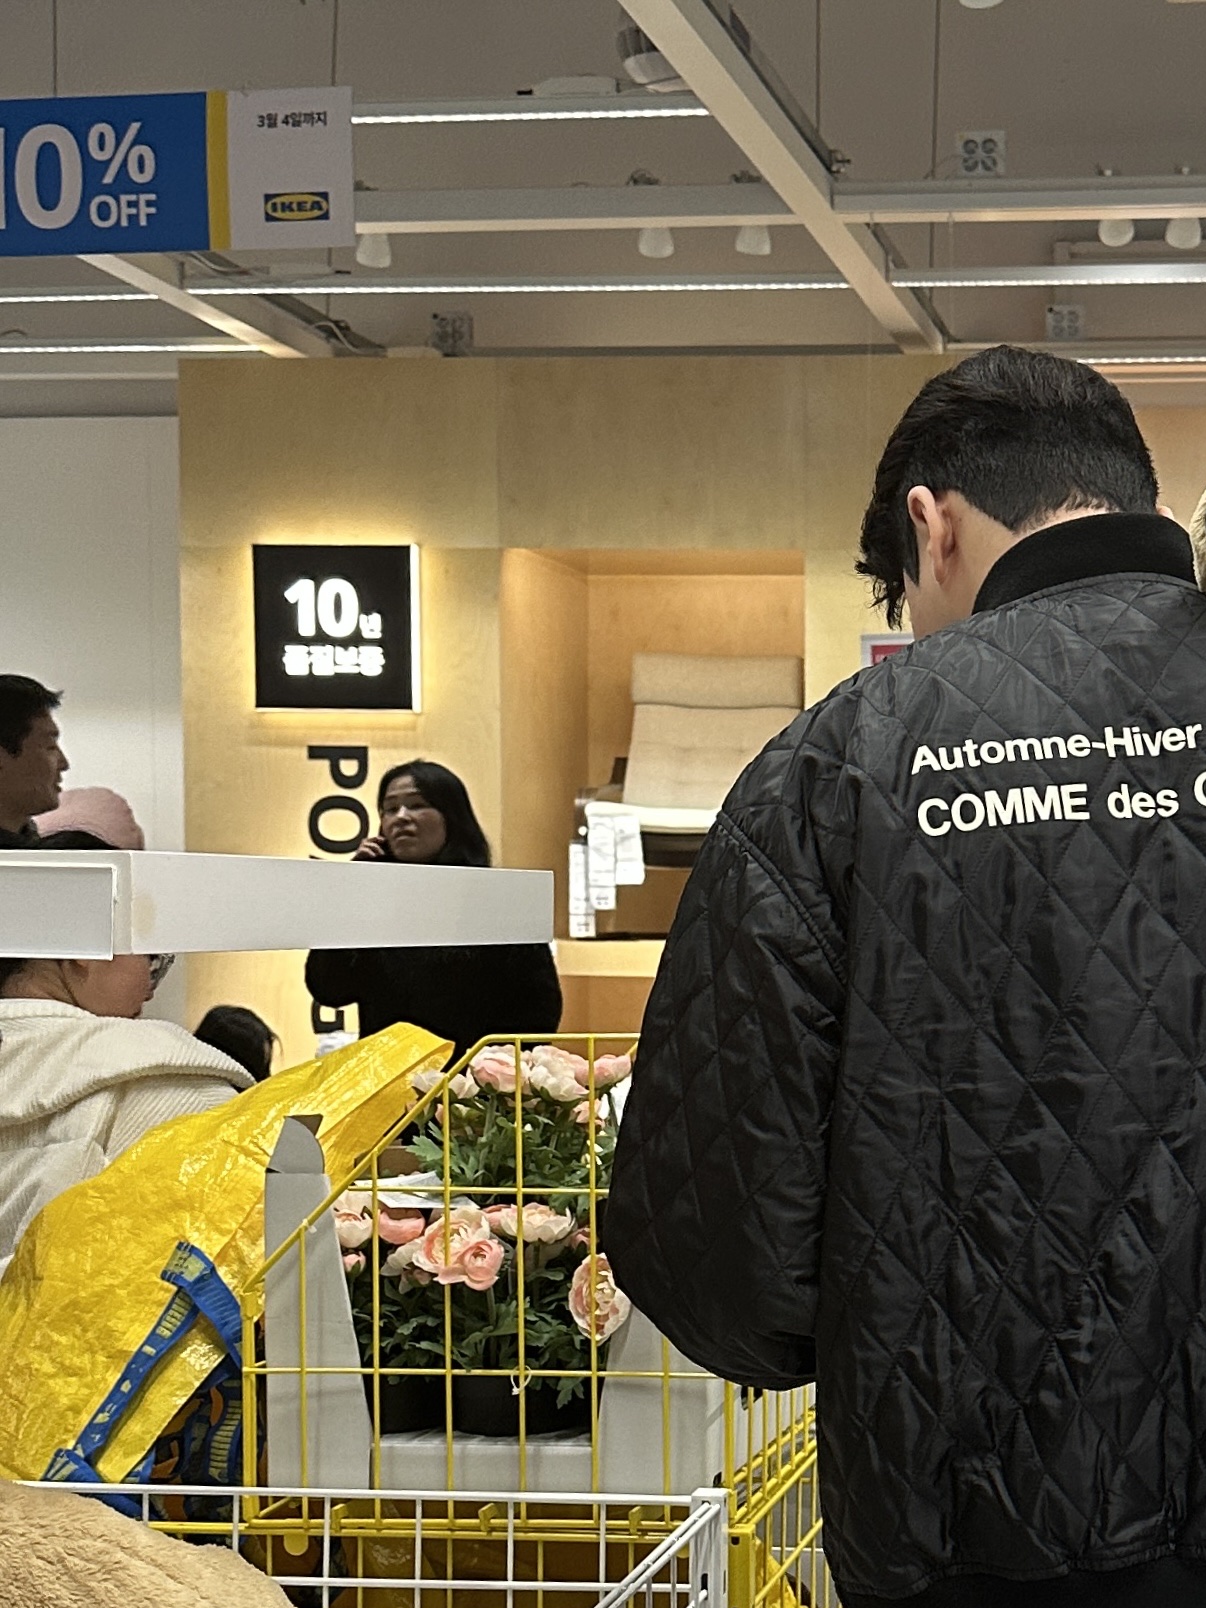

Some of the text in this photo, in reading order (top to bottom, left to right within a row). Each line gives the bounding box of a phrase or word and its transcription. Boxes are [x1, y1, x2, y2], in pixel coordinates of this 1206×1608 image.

[0, 122, 156, 230] 0%
[89, 193, 157, 228] OFF
[270, 200, 324, 213] IKEA
[911, 722, 1202, 775] Automne-Hiver
[917, 783, 1091, 837] COMME
[1107, 784, 1179, 818] des
